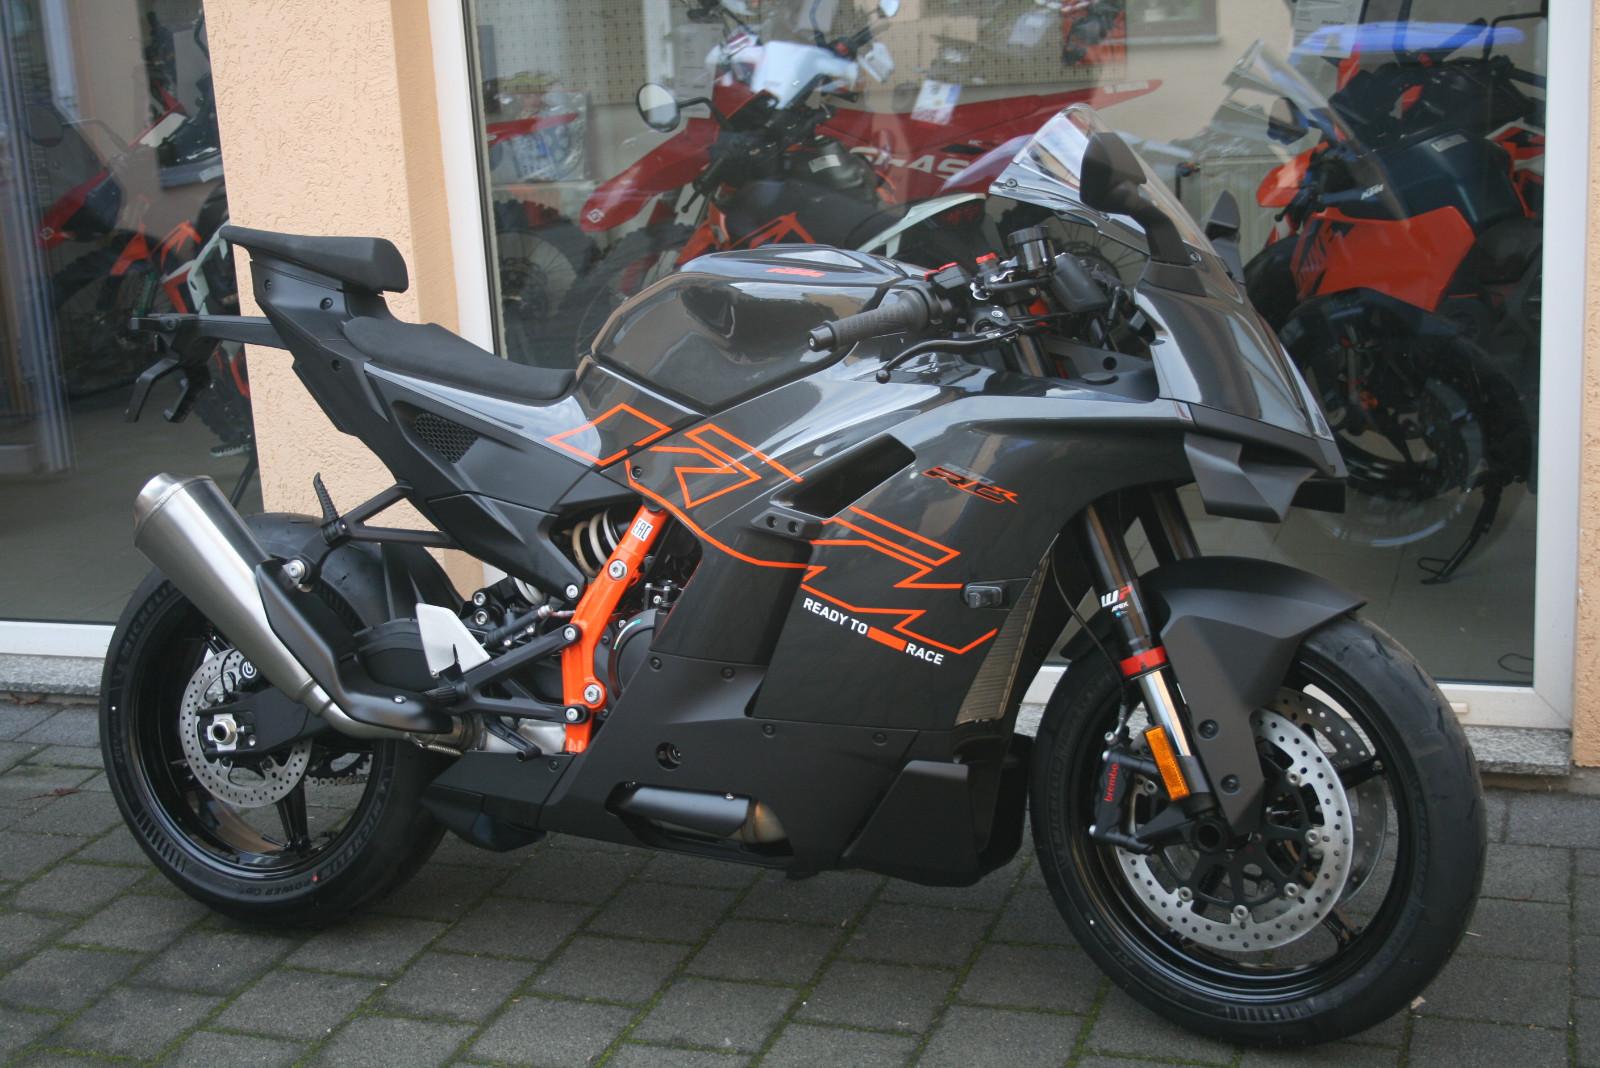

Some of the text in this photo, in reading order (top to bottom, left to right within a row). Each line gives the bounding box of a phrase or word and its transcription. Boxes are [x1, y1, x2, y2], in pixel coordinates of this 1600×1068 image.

[1360, 184, 1384, 201] KTM
[632, 519, 652, 540] EAC
[1101, 584, 1132, 608] WP
[802, 597, 945, 666] READY TO RACE
[1103, 762, 1120, 802] brembo
